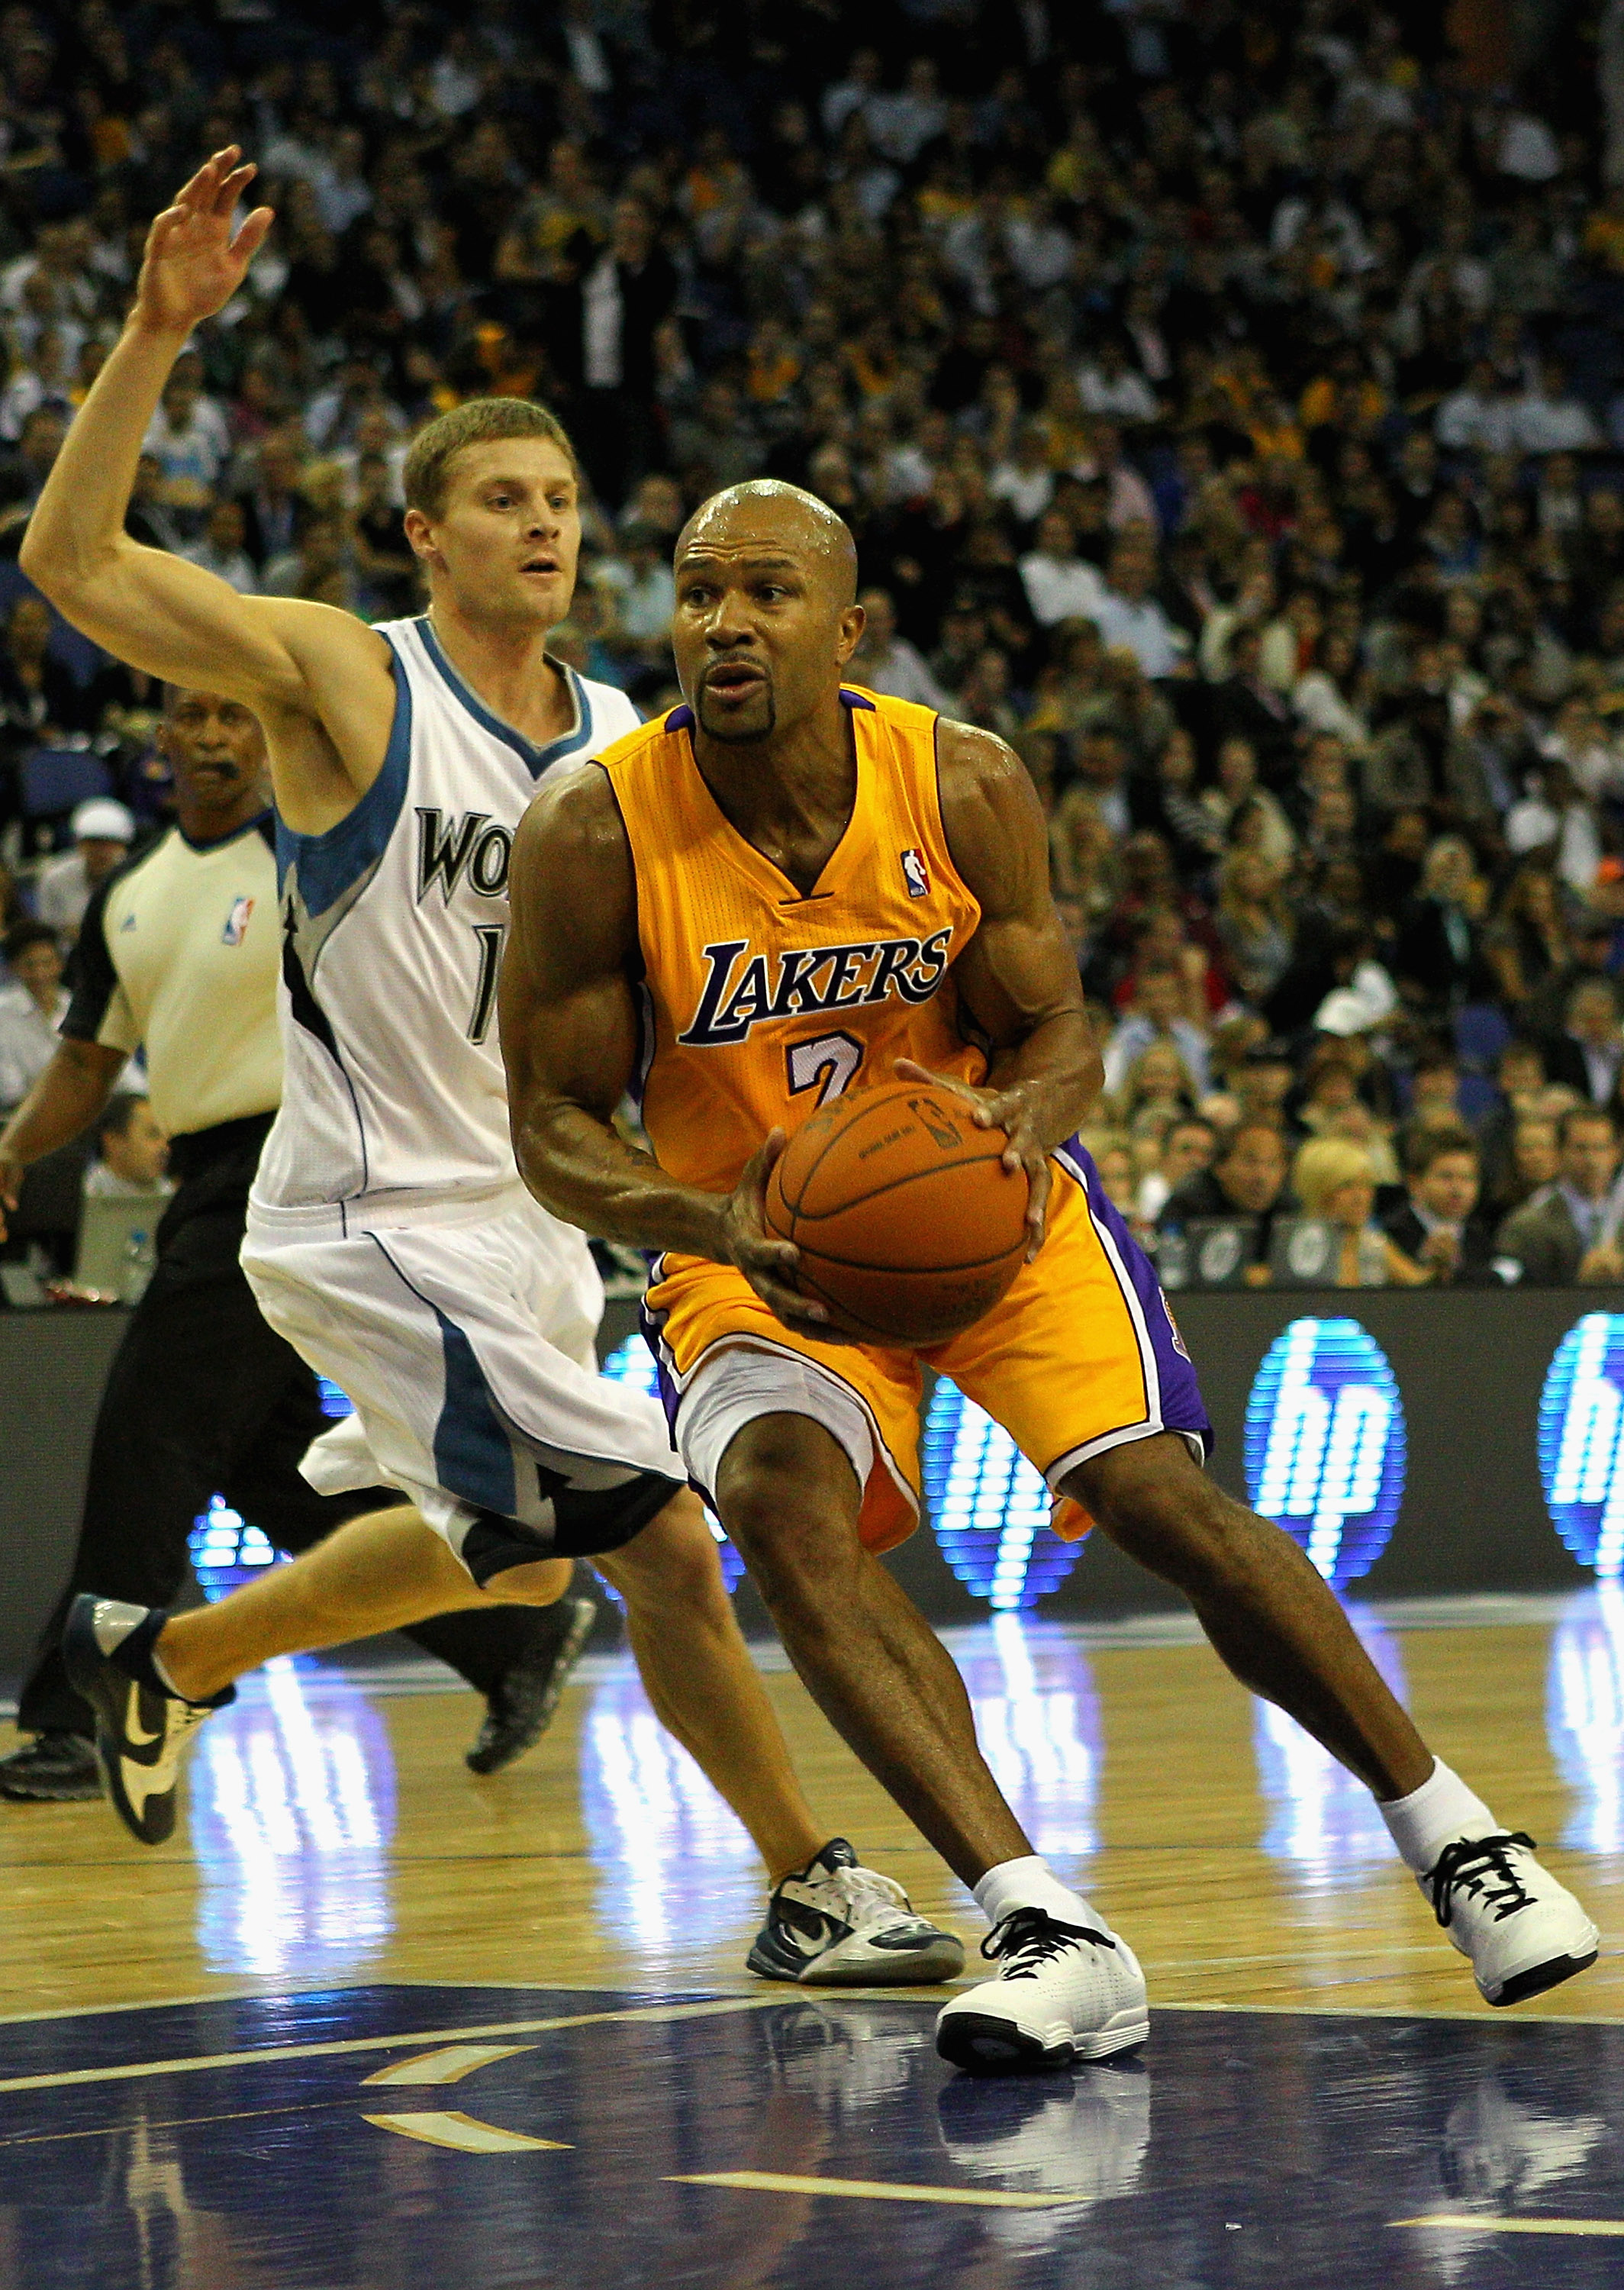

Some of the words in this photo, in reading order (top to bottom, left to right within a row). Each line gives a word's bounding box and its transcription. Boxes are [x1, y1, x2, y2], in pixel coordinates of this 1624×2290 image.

[414, 807, 511, 909] WO
[466, 924, 504, 1046] 1
[675, 925, 954, 1047] LAKERS
[1254, 1317, 1394, 1579] hp
